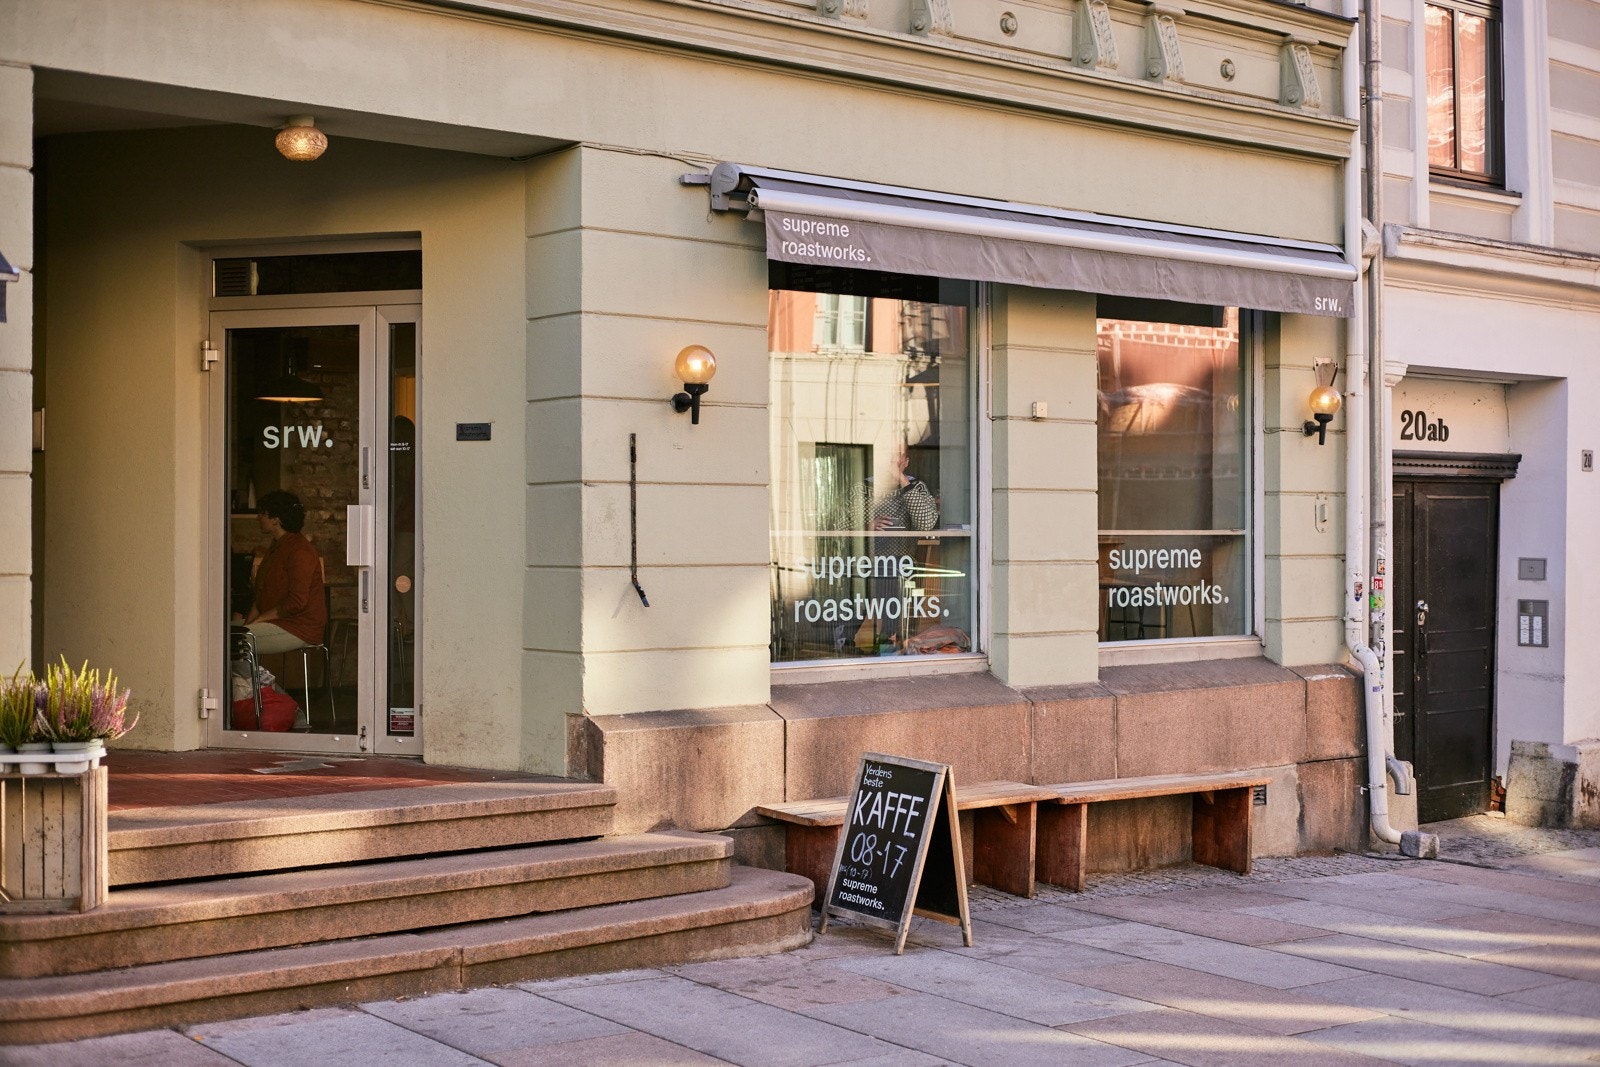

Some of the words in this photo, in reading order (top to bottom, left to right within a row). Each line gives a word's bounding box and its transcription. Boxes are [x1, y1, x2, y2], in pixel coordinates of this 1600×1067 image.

[782, 217, 850, 238] supreme
[782, 240, 872, 262] roastworks.
[1314, 296, 1342, 312] srw.
[262, 425, 334, 448] srw.
[1400, 410, 1449, 442] 20ab
[1583, 453, 1592, 468] 20
[796, 553, 914, 585] supreme
[1109, 548, 1202, 575] supreme
[1109, 580, 1230, 608] roastworks.
[794, 592, 950, 623] roastworks.
[863, 776, 884, 788] beste
[852, 790, 925, 838] KAFFE
[851, 832, 908, 879] 08-17
[842, 878, 878, 894] supreme
[838, 891, 885, 911] roastworks.
